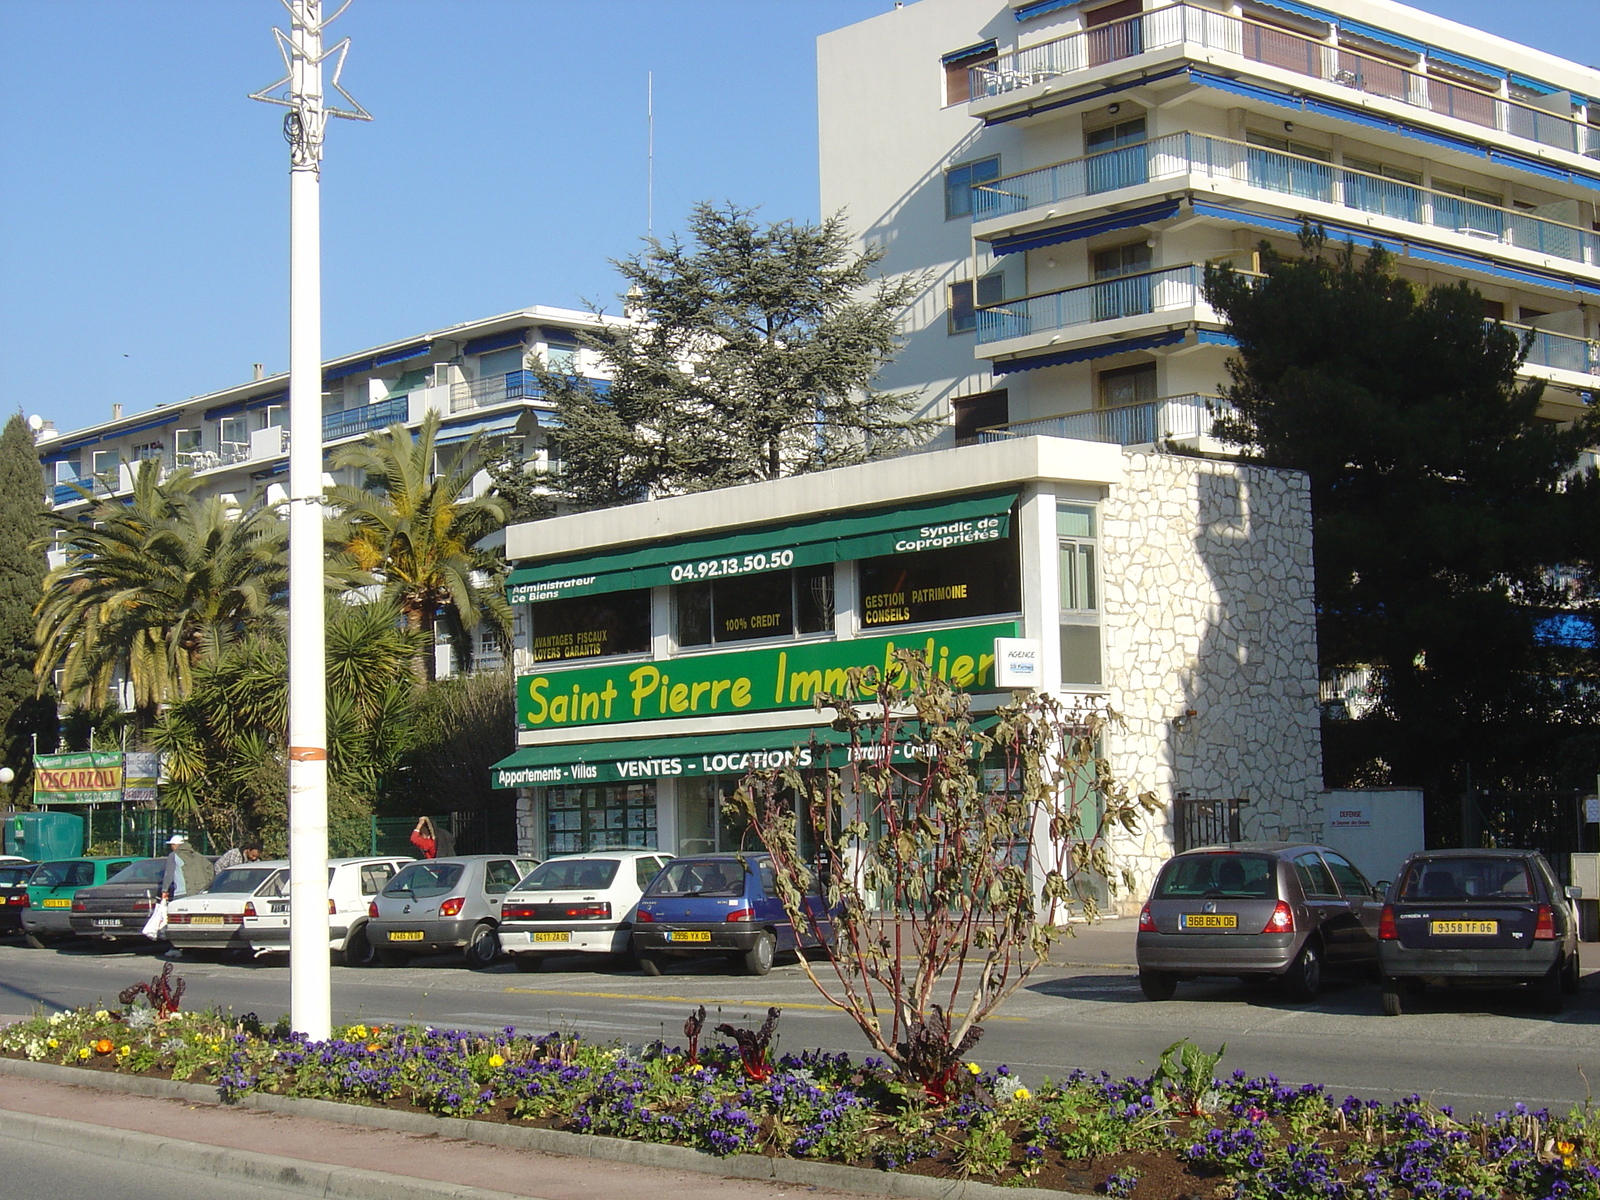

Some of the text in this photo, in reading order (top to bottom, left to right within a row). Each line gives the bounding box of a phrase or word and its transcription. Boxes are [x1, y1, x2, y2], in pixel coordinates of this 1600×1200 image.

[920, 518, 999, 538] Syndic de
[895, 528, 999, 551] Copropriétés
[671, 549, 794, 582] 04.92.13.50.50
[512, 576, 596, 594] Administrateur
[511, 590, 559, 603] De Biens
[865, 584, 968, 609] GESTION PATRIMOINE
[725, 613, 780, 632] 100% CREDIT
[865, 607, 910, 624] CONSEILS
[534, 630, 608, 649] AVANTAGES FISCAUX
[534, 643, 601, 661] LOYERS GARANTIS
[1007, 650, 1035, 659] AGENCE
[527, 677, 618, 724] Saint
[628, 665, 752, 717] Pierre
[498, 766, 562, 787] Appartements
[571, 763, 597, 779] Villas
[616, 757, 683, 777] VENTES
[702, 748, 813, 772] LOCATIONS
[39, 770, 117, 789] PESCARZOLI
[1339, 810, 1362, 818] DEFENSE
[1188, 916, 1234, 926] 968 BEN 06
[1437, 923, 1492, 933] 9358 YF 06
[535, 933, 569, 941] 6417 ZA 06
[691, 932, 700, 940] YX
[701, 932, 710, 940] 06
